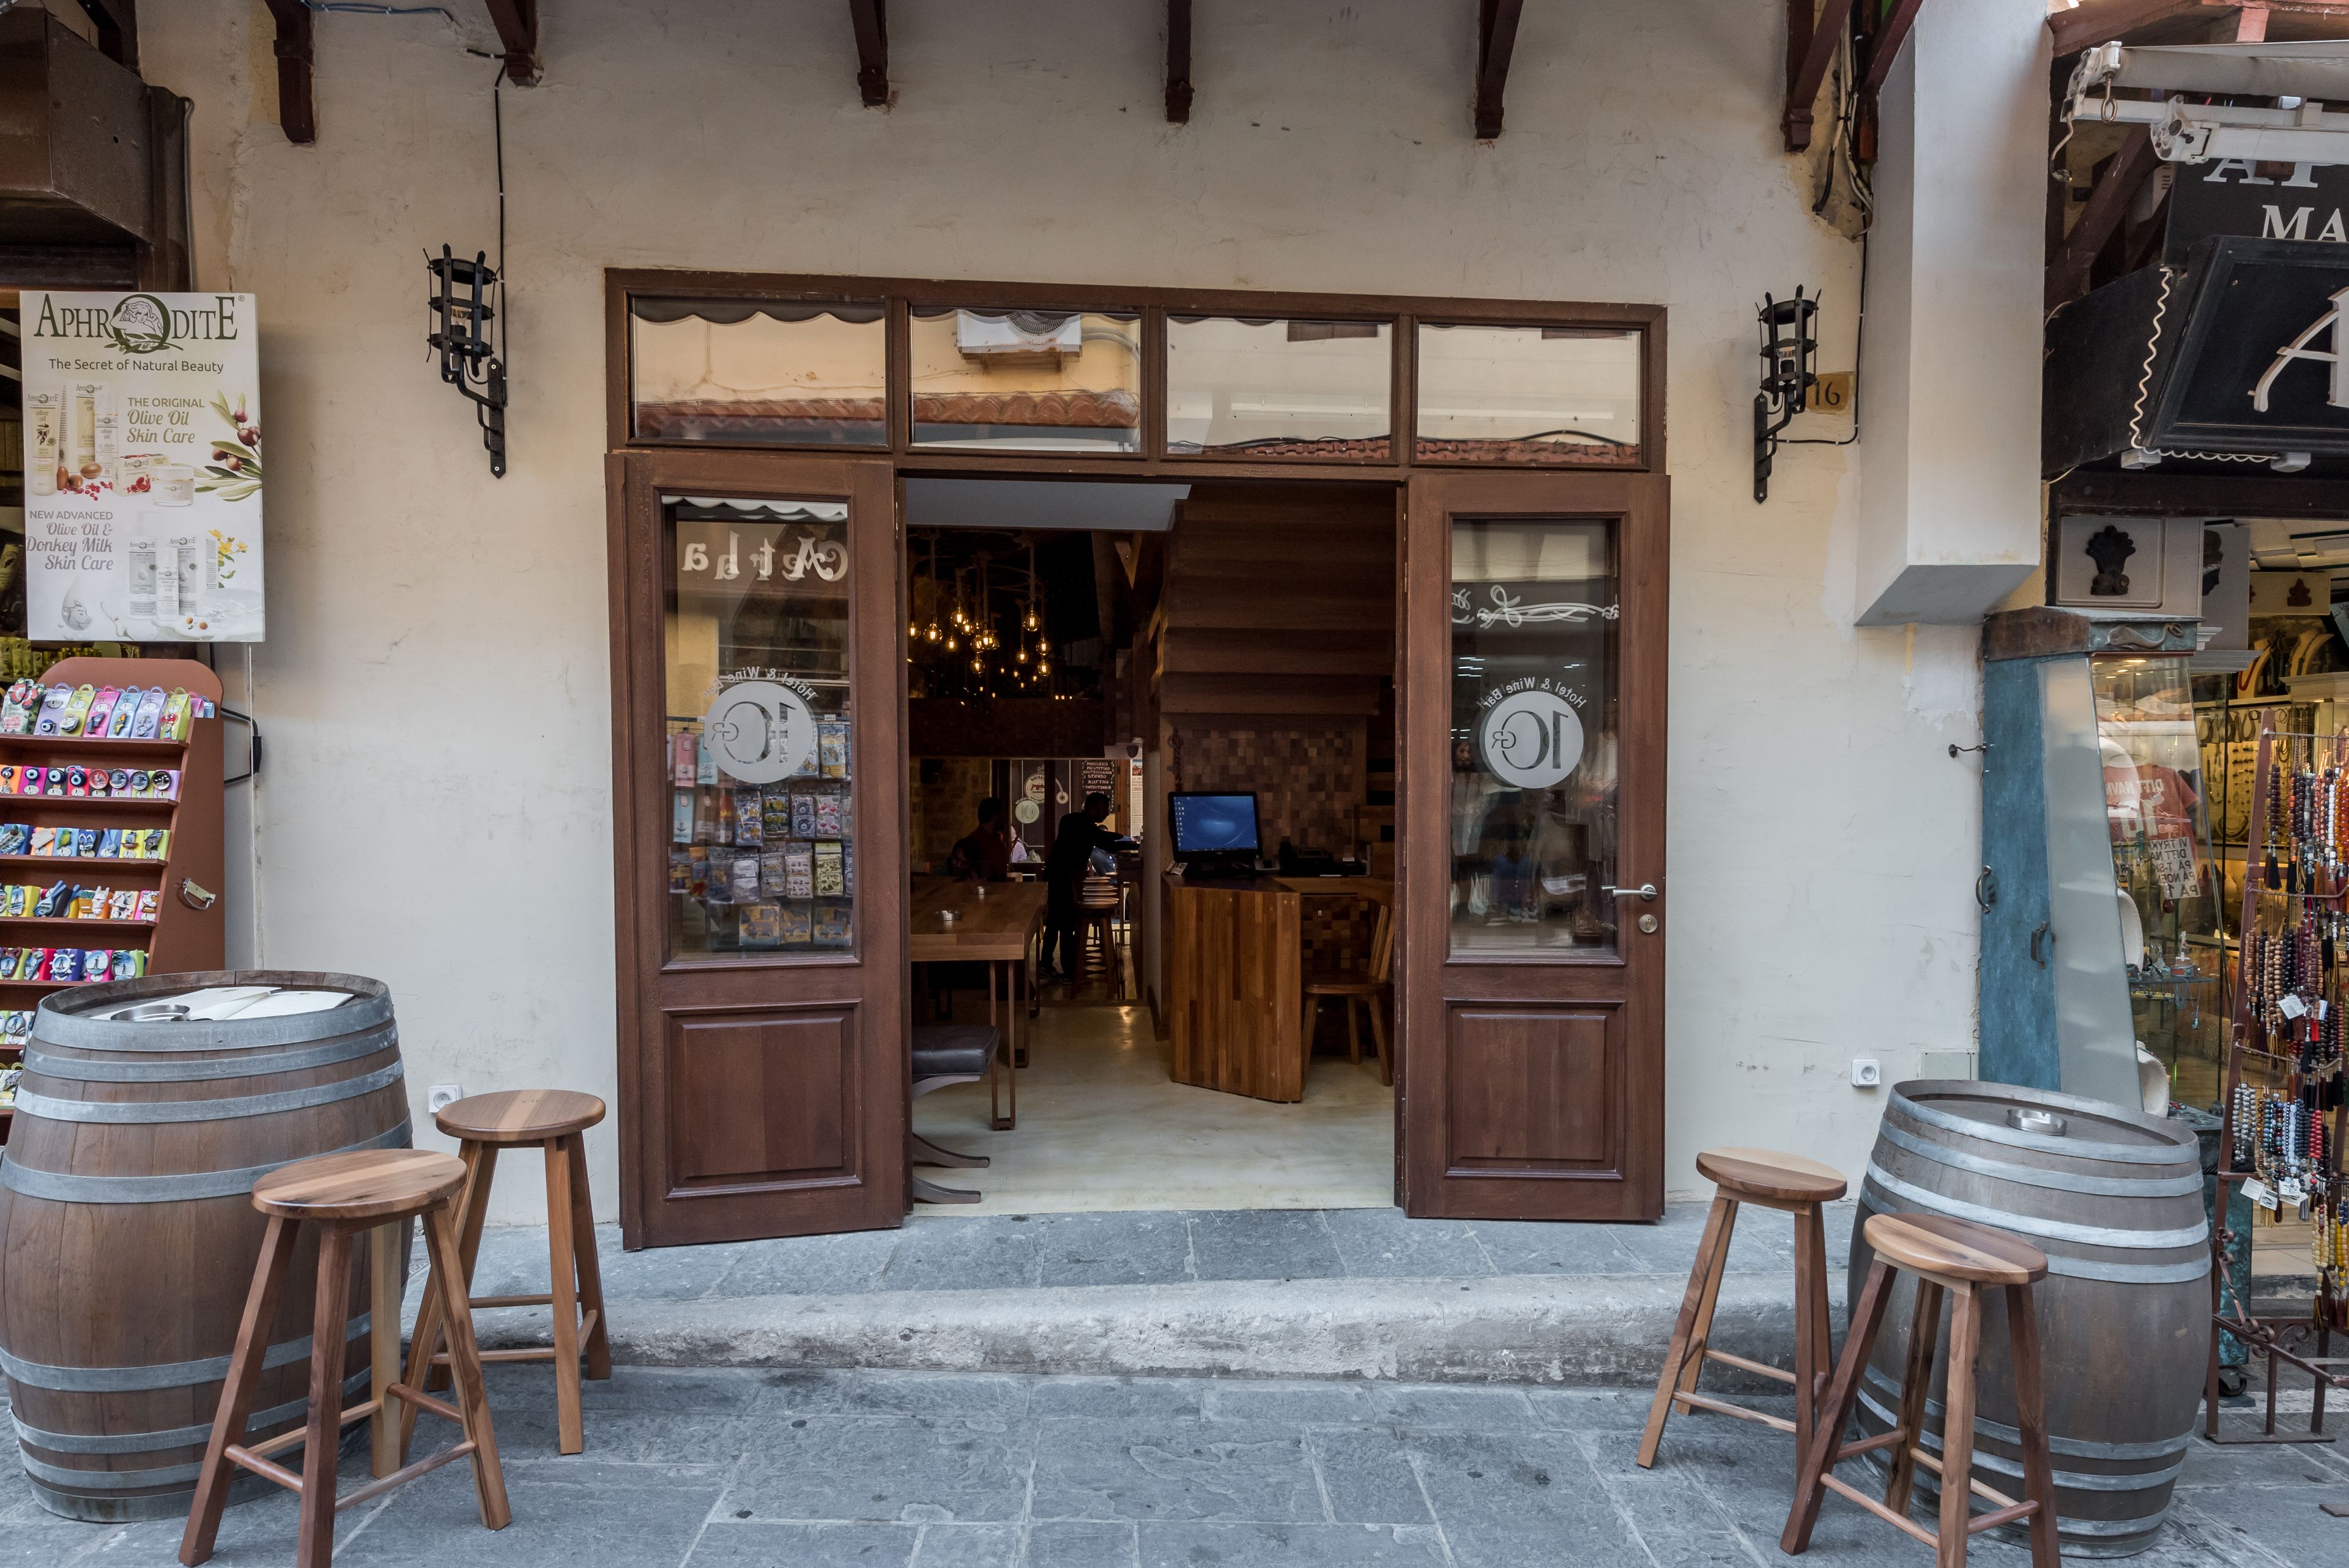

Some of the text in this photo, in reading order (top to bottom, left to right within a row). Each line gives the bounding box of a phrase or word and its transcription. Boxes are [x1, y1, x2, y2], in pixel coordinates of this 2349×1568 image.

[34, 294, 237, 354] APHRODITE
[49, 359, 224, 374] The Secret of Natural Beauty
[1815, 381, 1841, 406] 16
[127, 398, 205, 407] THE ORIGINAL
[127, 409, 189, 425] Olive Oil
[127, 427, 195, 444] Skin Care
[29, 510, 113, 520] NEW ADVANCED
[46, 522, 113, 536] Olive Oil &
[26, 536, 113, 556] Donkey Milk
[45, 554, 114, 570] Skin Care
